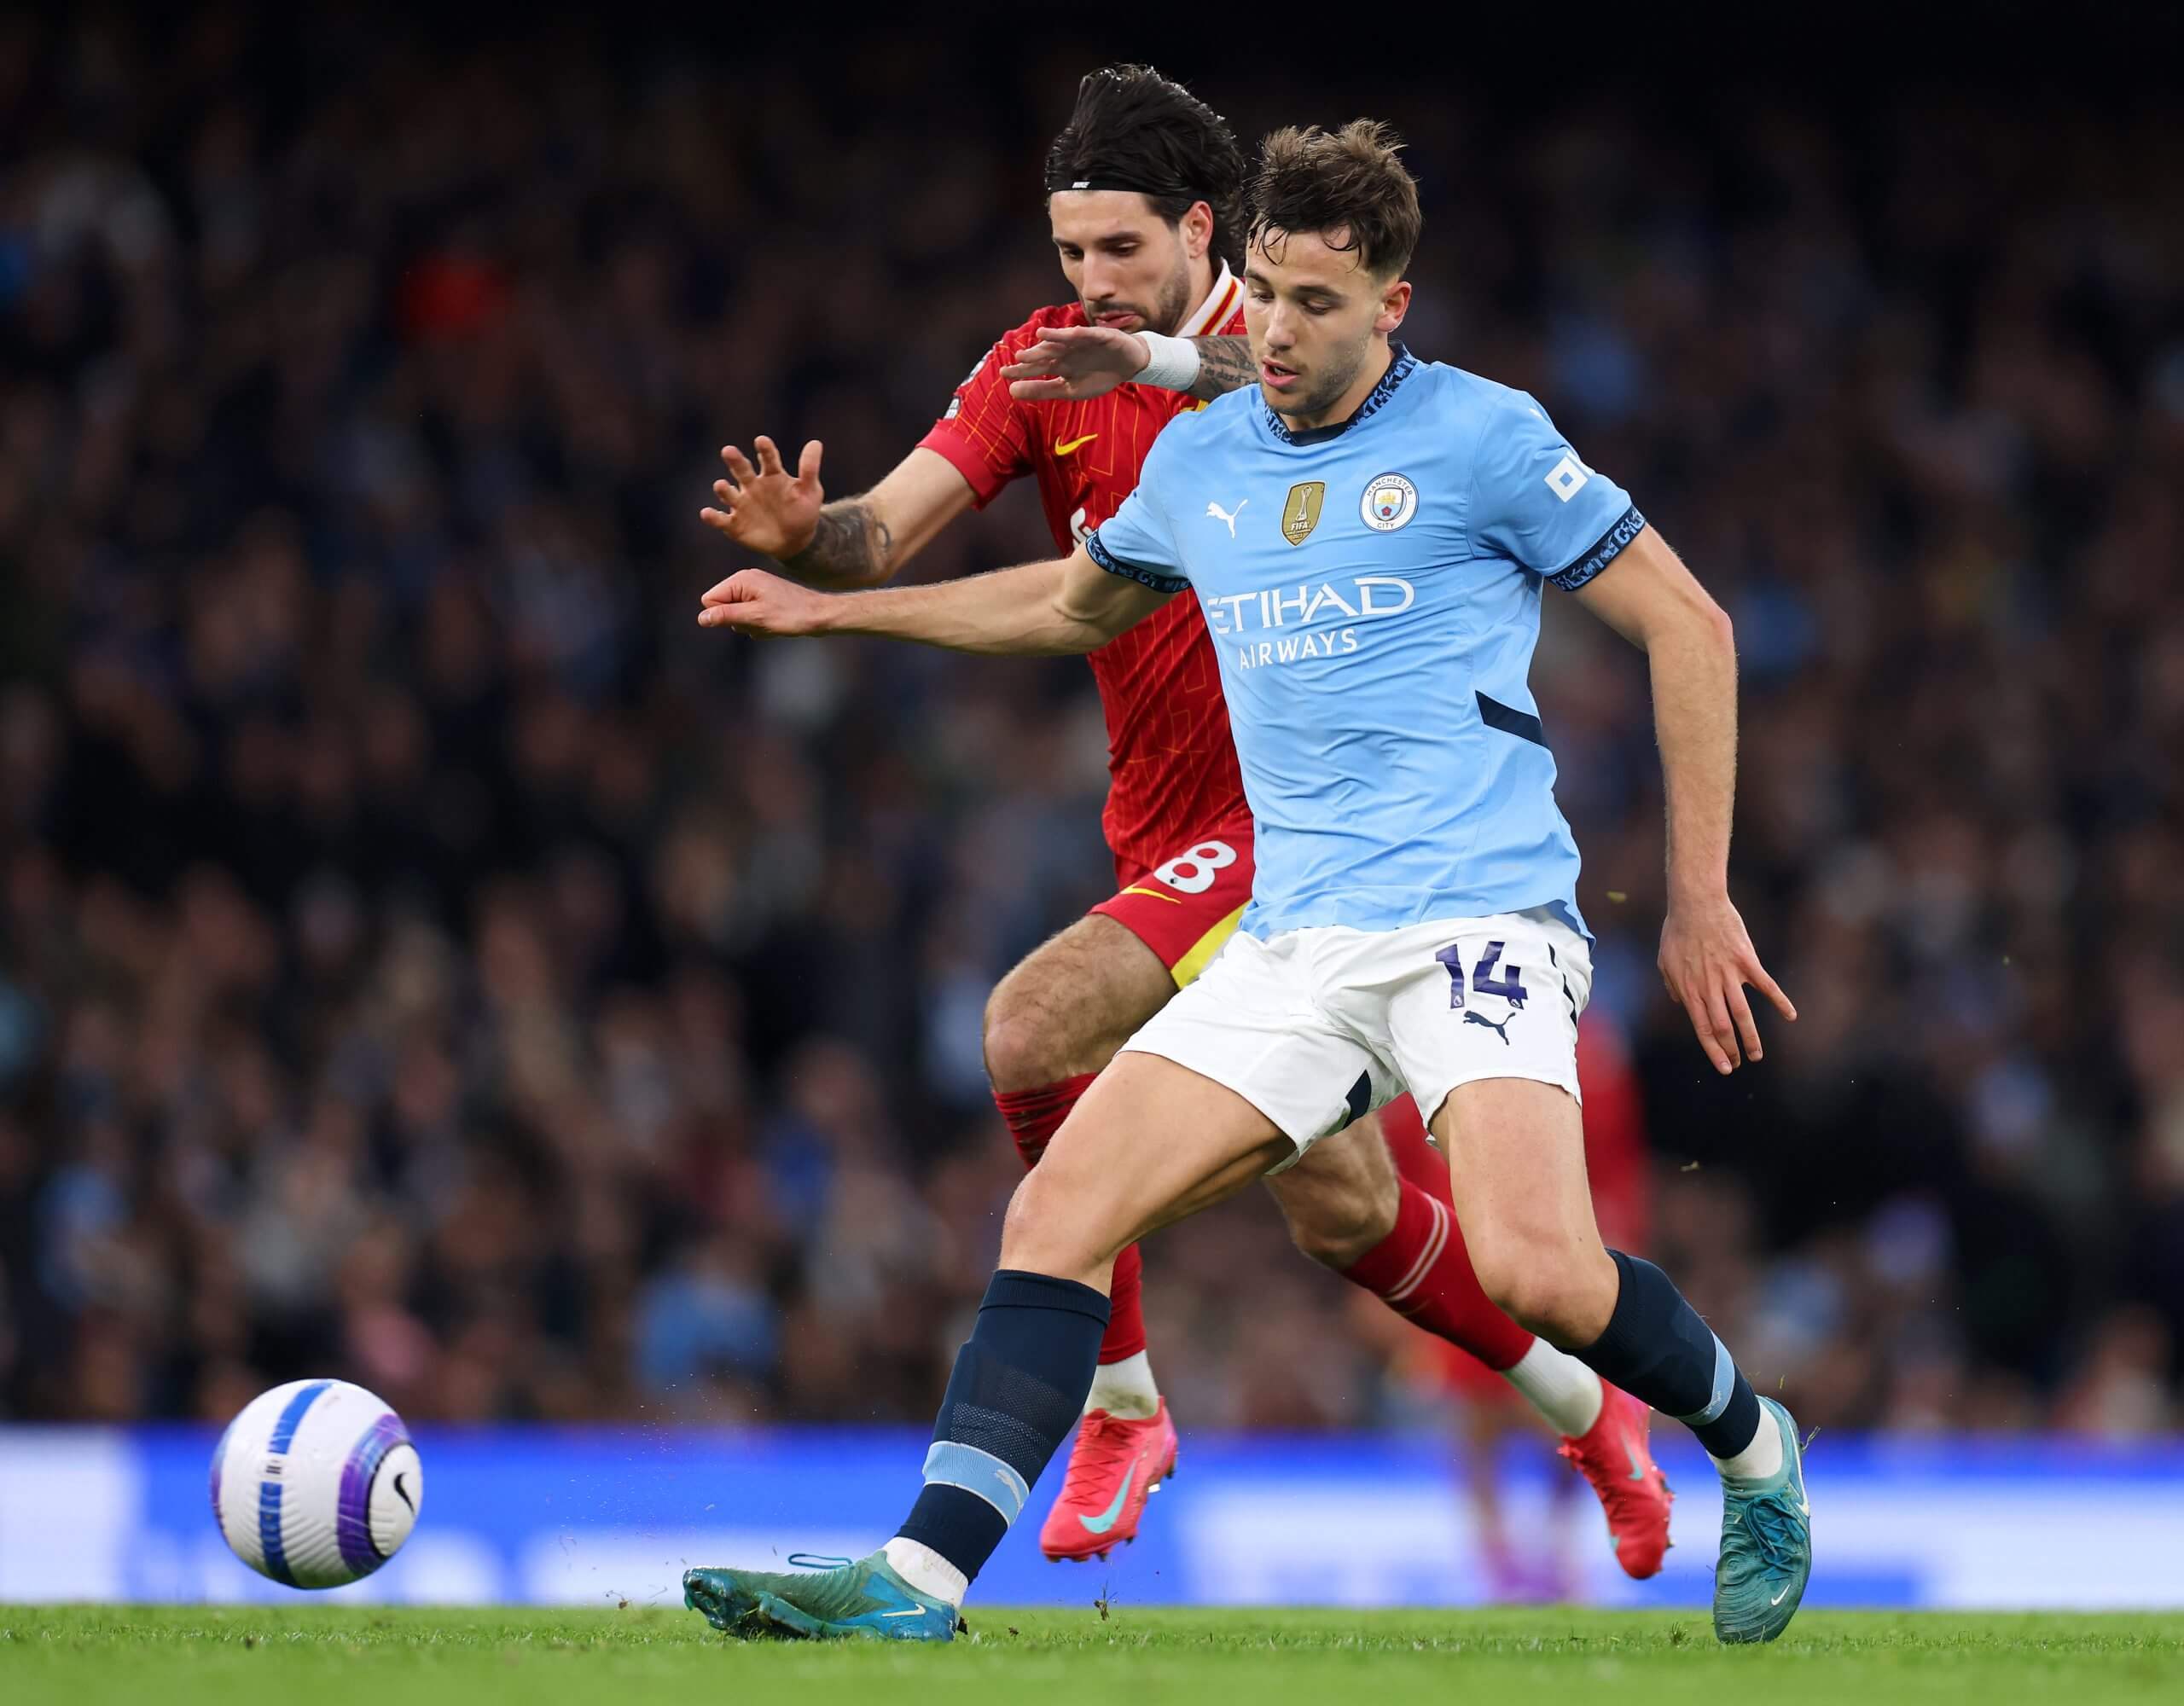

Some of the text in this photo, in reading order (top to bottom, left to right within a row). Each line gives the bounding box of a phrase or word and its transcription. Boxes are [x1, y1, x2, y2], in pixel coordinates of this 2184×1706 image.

[1367, 477, 1413, 496] MANCHESTER
[1291, 521, 1309, 531] FIFA
[1207, 577, 1414, 635] ETIHAD
[1240, 628, 1358, 671] AIRWAYS
[1153, 840, 1237, 894] 8
[1435, 941, 1528, 1010] 14
